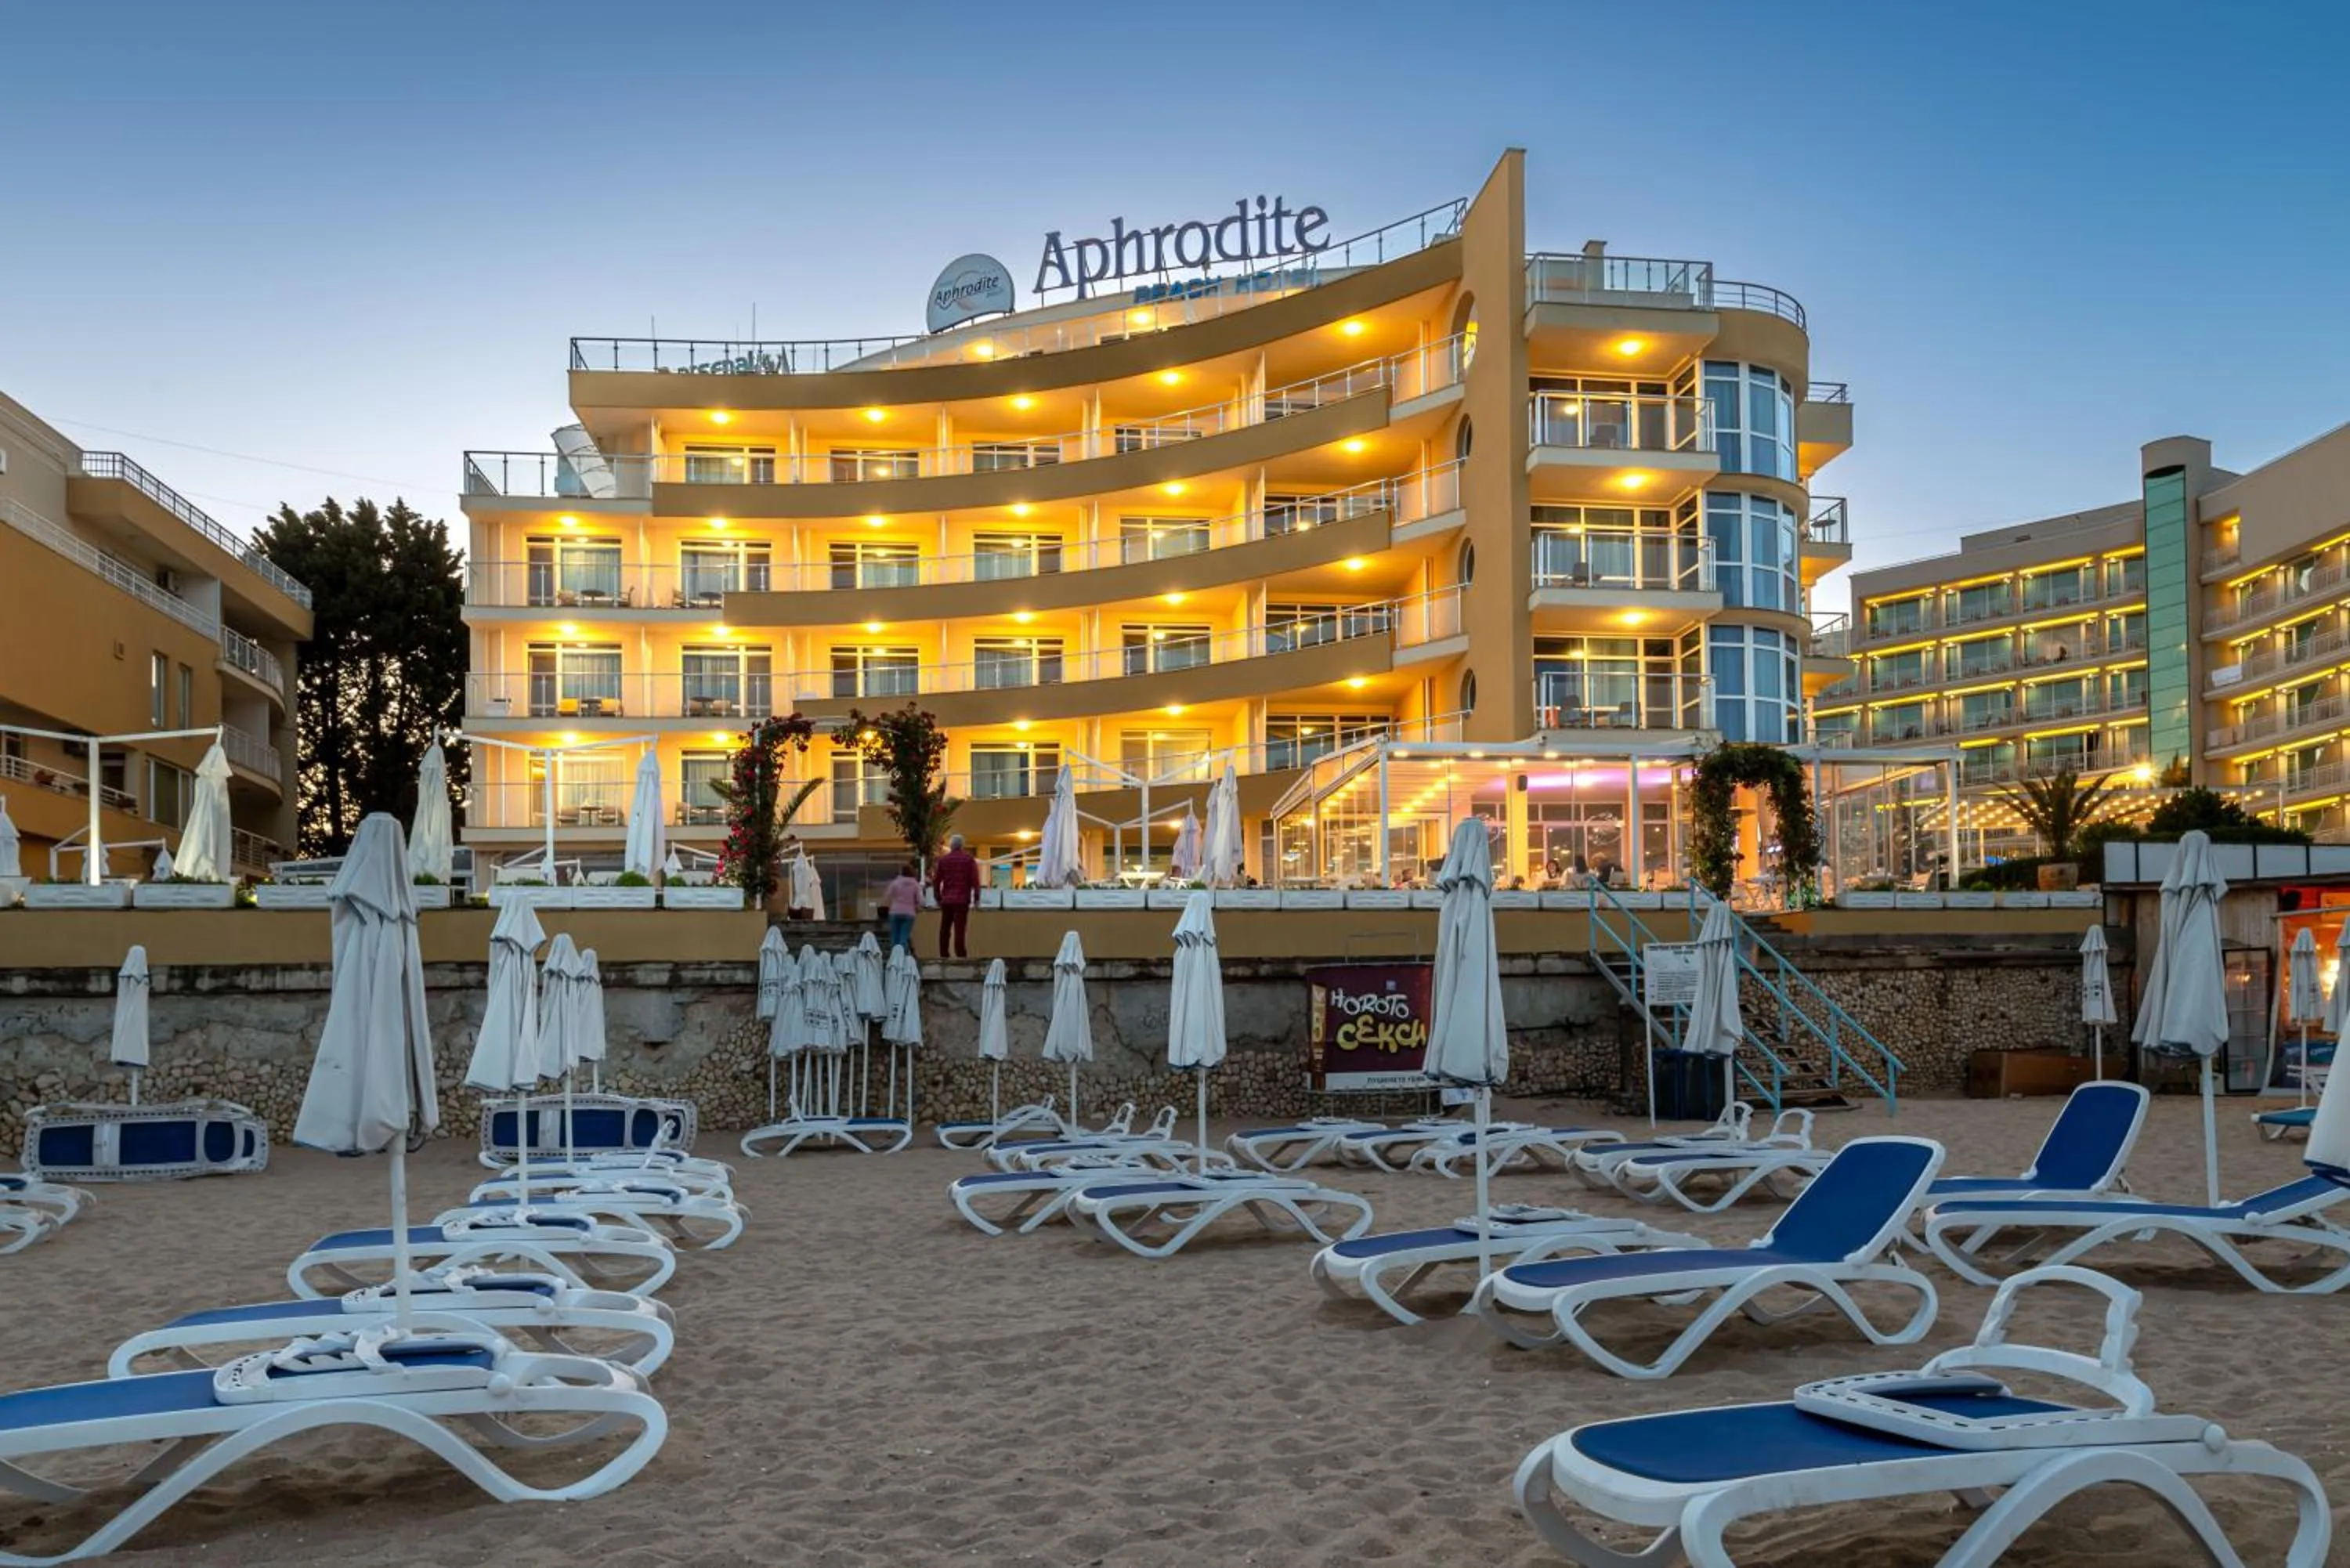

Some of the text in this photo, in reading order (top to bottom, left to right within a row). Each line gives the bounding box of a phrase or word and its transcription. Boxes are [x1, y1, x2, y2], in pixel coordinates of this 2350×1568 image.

[1032, 195, 1331, 300] Aphrodite
[935, 275, 999, 303] Aphrodite
[1133, 276, 1220, 304] BEACH
